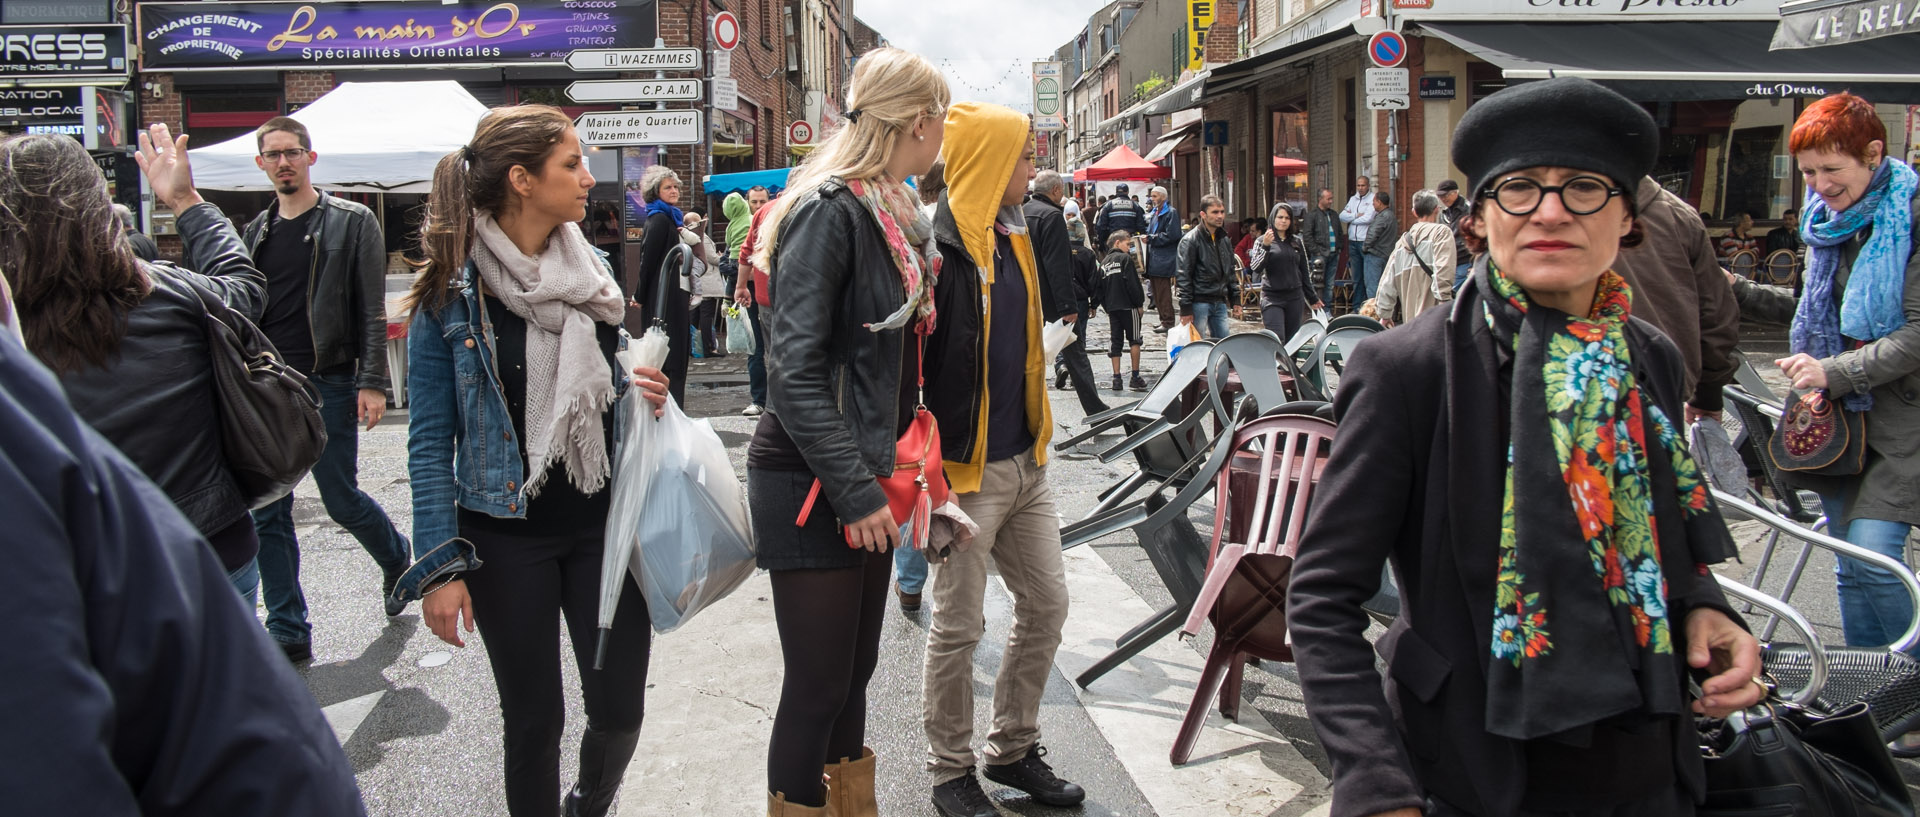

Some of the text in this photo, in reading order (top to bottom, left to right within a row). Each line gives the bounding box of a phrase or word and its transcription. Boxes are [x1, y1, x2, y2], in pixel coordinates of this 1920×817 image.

[7, 6, 106, 17] INFORMATIQUE
[573, 12, 609, 21] TAJINES
[147, 15, 263, 40] CHANGEMENT
[193, 27, 211, 36] DE
[266, 5, 338, 52] La
[354, 18, 436, 41] main
[565, 25, 617, 33] GRILLADES
[1193, 0, 1210, 61] ELIX
[1815, 16, 1843, 40] LE
[568, 37, 615, 45] TRAITEUR
[0, 34, 107, 60] RESS
[160, 39, 243, 60] PROPRIETAIRE
[302, 45, 501, 61] Spécialités Orientales
[551, 50, 569, 59] plac
[621, 53, 692, 64] WAZEMMES
[642, 85, 693, 95] C.P.A.M.
[1746, 83, 1825, 97] Au Presto
[586, 116, 693, 127] Mairie de Quartier
[587, 131, 648, 140] Wazemmes
